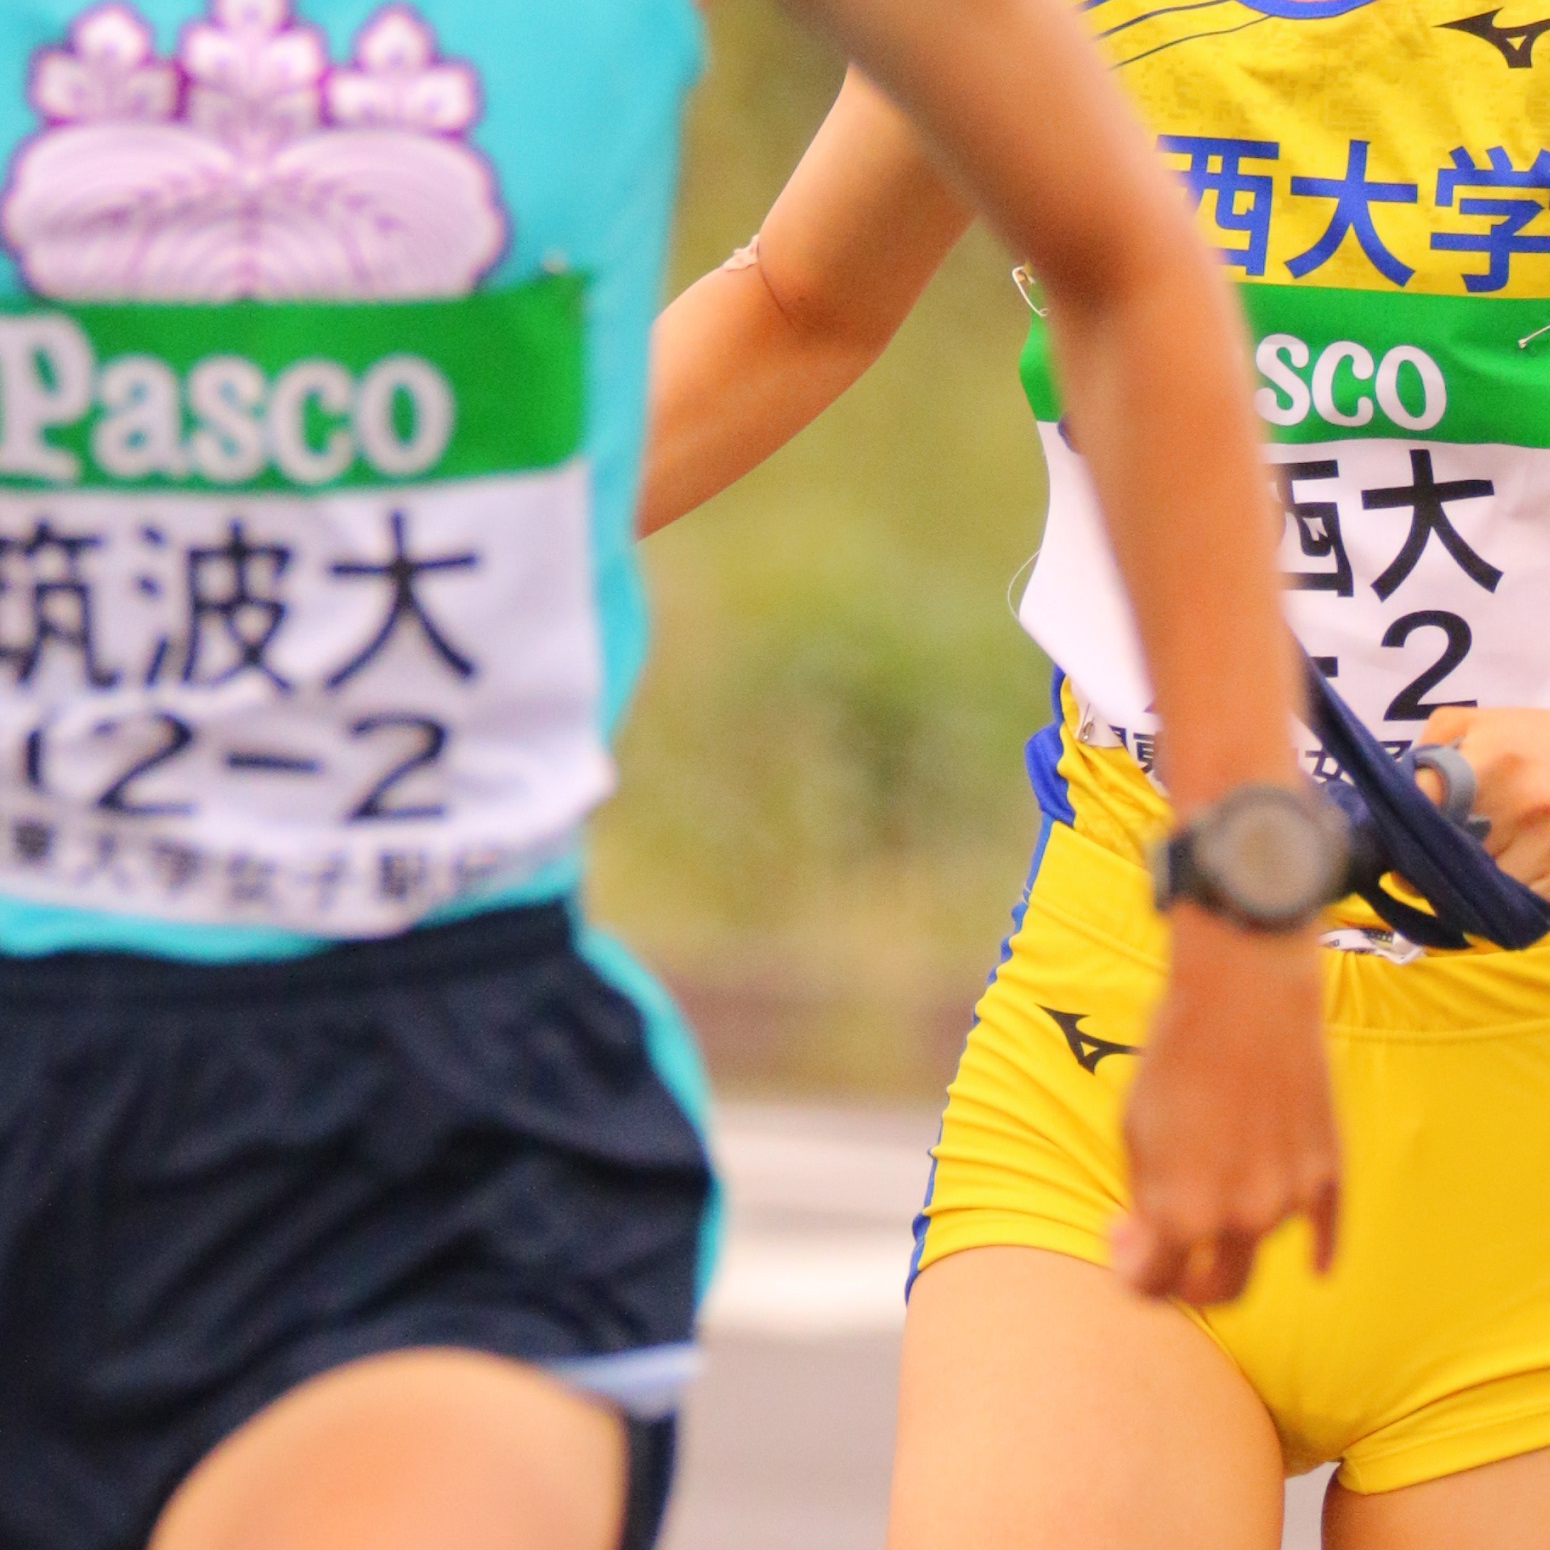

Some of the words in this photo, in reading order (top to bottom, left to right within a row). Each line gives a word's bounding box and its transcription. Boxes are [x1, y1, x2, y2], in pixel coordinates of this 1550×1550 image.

[0, 315, 456, 485] Pasco
[1255, 333, 1447, 431] sco
[1270, 450, 1504, 602] 西大
